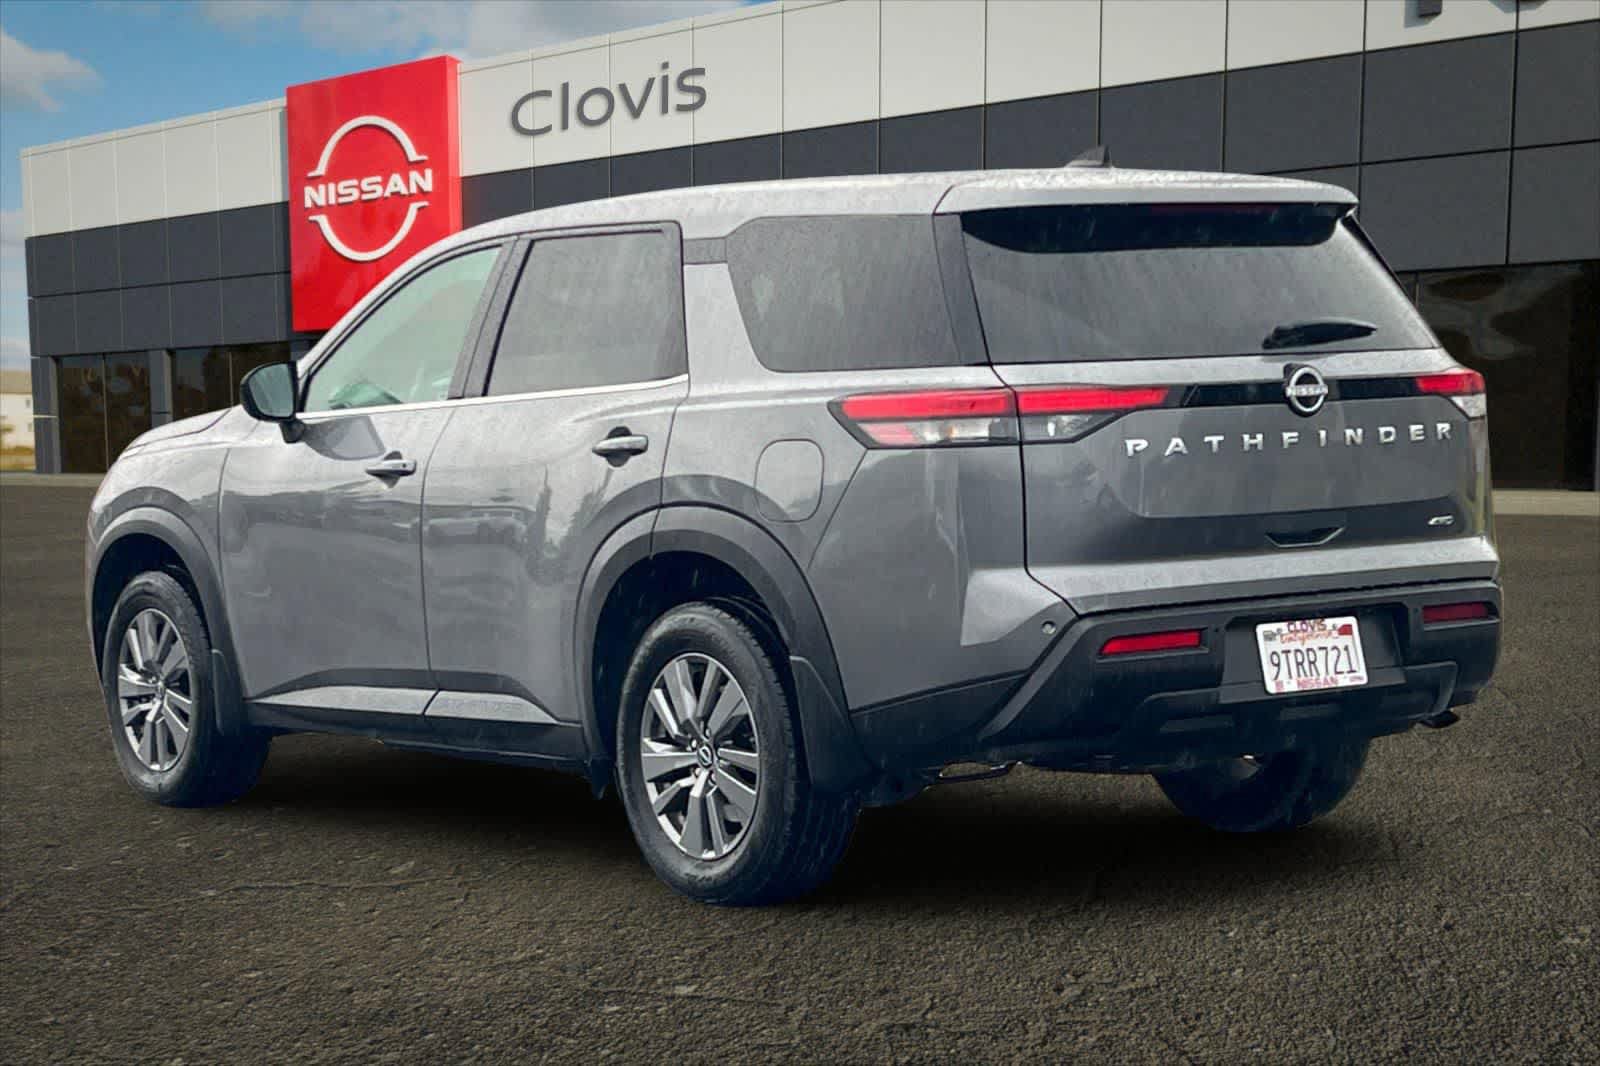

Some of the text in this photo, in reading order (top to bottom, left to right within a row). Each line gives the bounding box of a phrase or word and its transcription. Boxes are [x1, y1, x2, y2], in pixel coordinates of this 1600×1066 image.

[511, 61, 707, 136] Clovis
[304, 168, 432, 208] NISSAN
[1125, 422, 1452, 456] PATHFINDER
[1286, 618, 1327, 632] CLOVIS
[1270, 644, 1357, 680] 9TRR721
